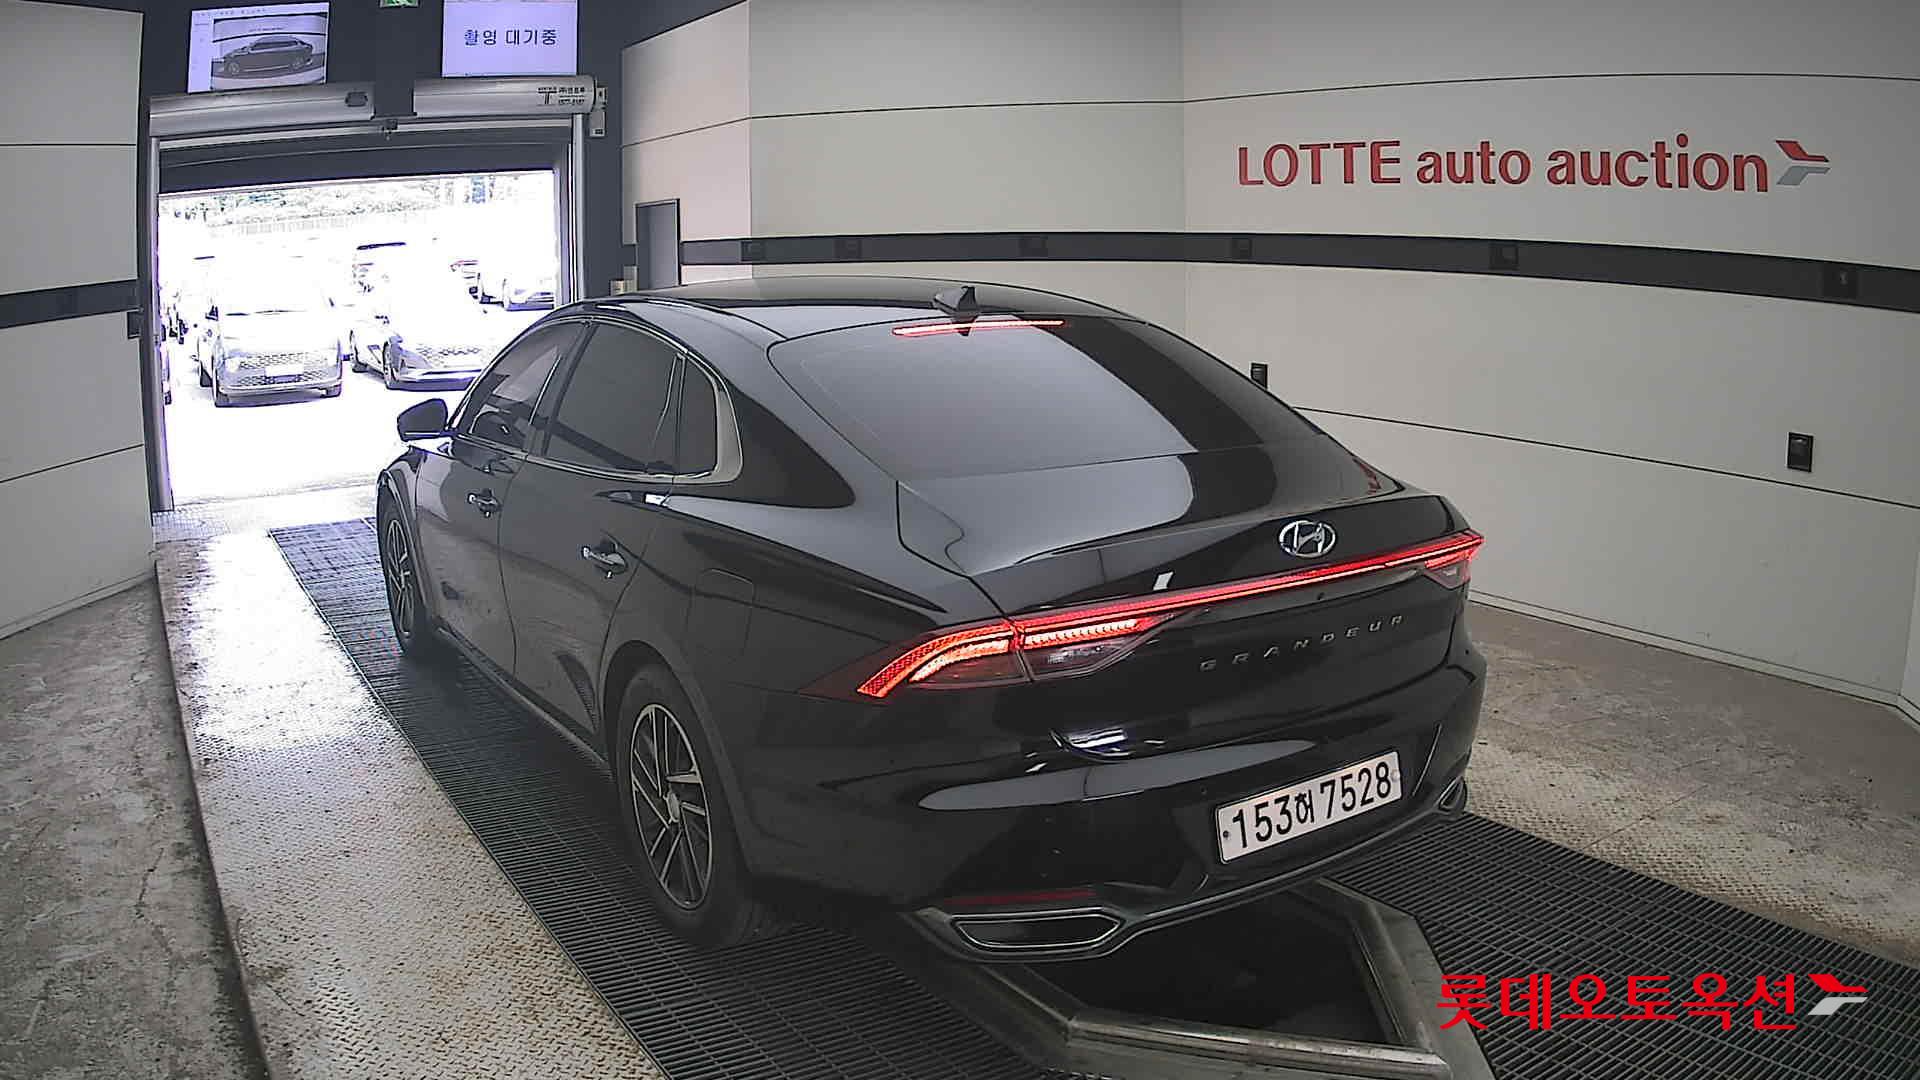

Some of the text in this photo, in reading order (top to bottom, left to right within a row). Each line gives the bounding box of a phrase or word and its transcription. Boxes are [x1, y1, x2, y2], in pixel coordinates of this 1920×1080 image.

[464, 29, 557, 46] 촬영 대기중
[1238, 133, 1768, 192] LOTTE auto auction
[1199, 615, 1403, 671] GRANDEUR
